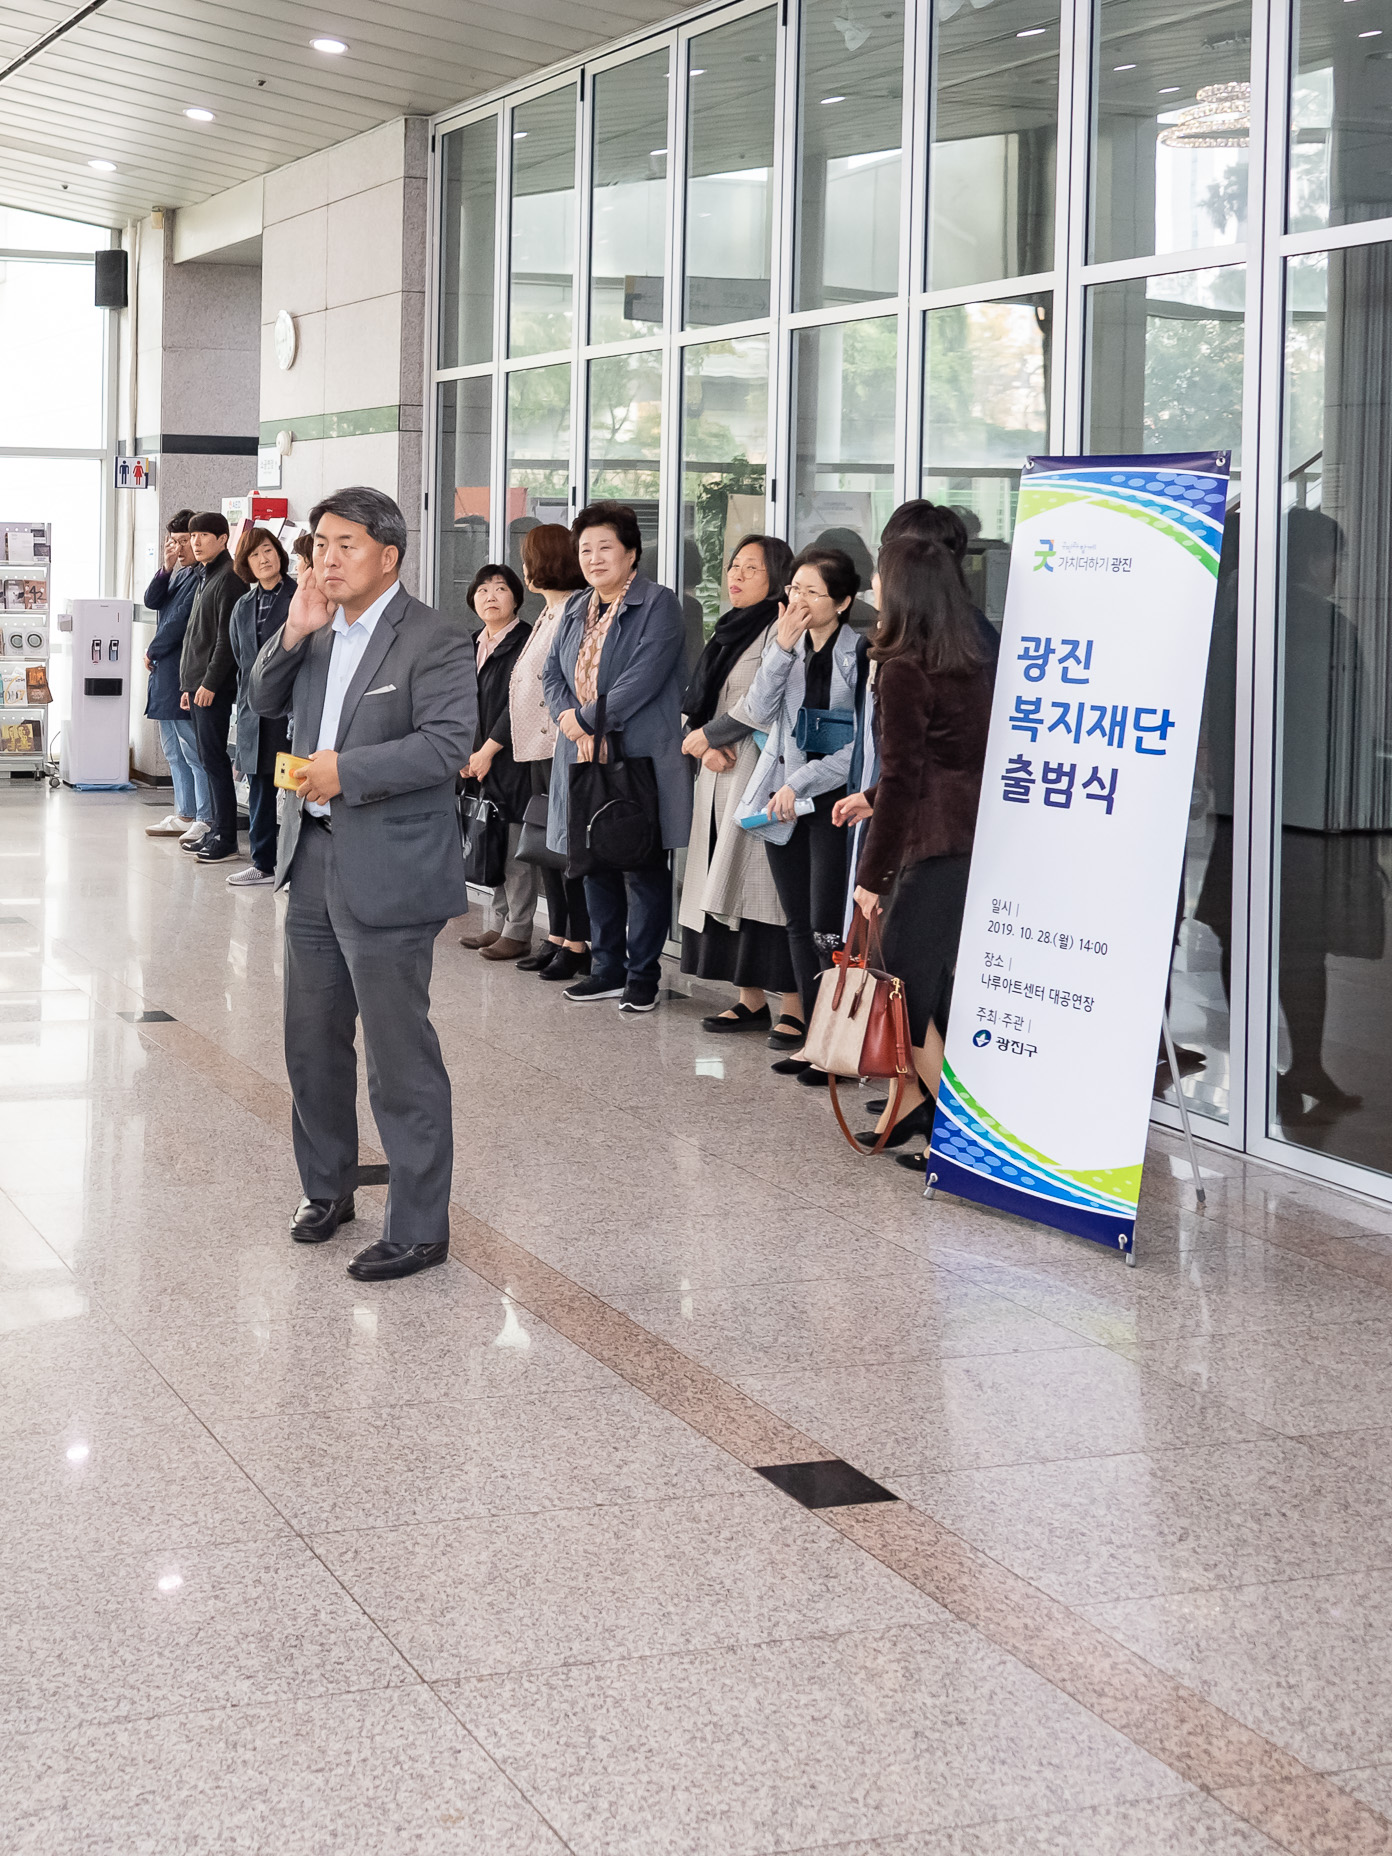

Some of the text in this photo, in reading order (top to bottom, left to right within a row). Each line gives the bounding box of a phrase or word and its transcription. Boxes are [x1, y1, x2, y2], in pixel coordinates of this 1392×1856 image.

[1058, 556, 1132, 573] 가치더하기 광진
[1017, 636, 1094, 685] 광진
[1009, 695, 1175, 756] 복지재단
[1001, 753, 1119, 815] 출범식
[992, 898, 1012, 916] 일시
[987, 920, 1108, 956] 2019. 10. 28.(월) 14:00
[984, 951, 1004, 968] 장소
[981, 973, 1095, 1013] 나루아트센터 대공연장
[995, 1036, 1038, 1058] 광진구
